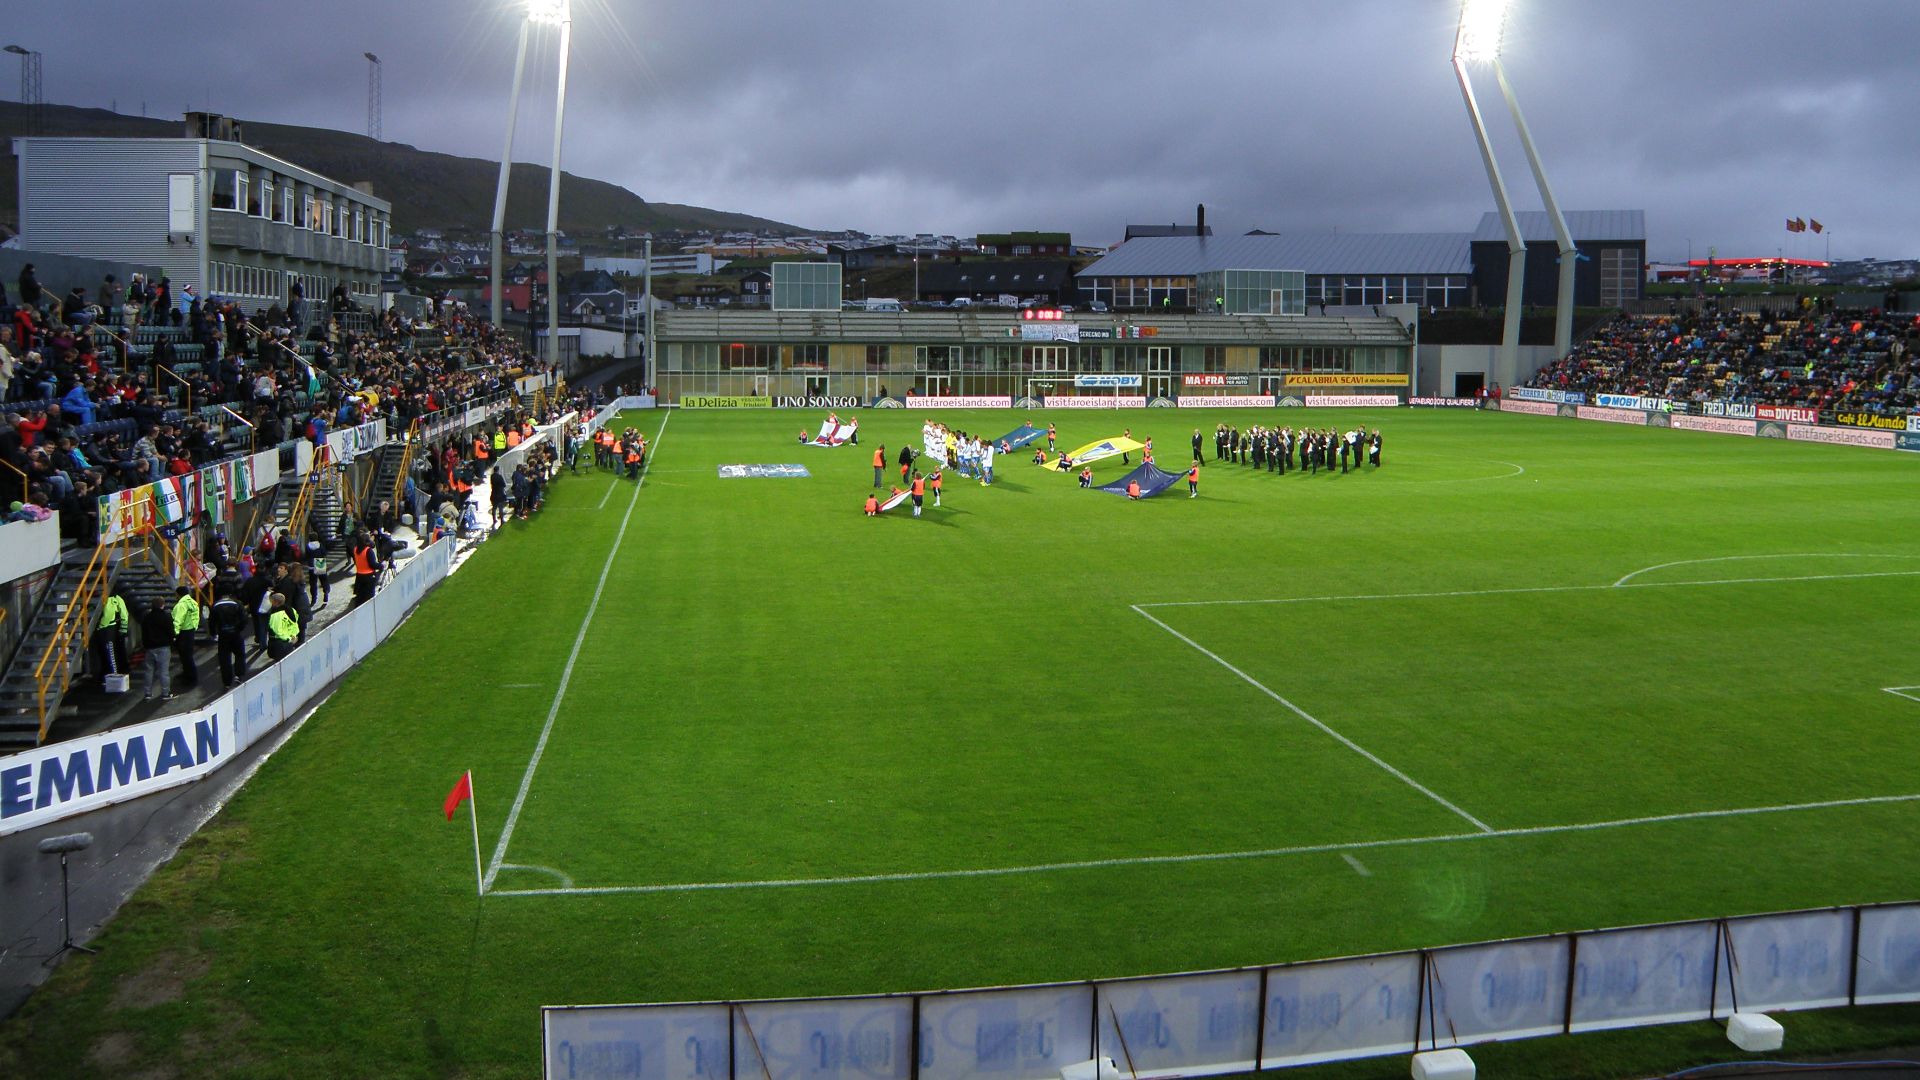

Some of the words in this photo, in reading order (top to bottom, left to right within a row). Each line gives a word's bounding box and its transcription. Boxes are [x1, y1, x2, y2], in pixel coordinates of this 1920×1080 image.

[1099, 376, 1139, 385] MOBY
[1296, 376, 1338, 384] CALABRIA
[1340, 376, 1364, 384] SCAVI
[685, 397, 695, 407] la
[698, 397, 738, 407] Delizia
[777, 396, 806, 407] LINO
[808, 396, 857, 407] SONEGO
[908, 398, 1010, 407] visitfaroeislands.com
[1046, 398, 1144, 407] visitfaroeislands.com
[1179, 398, 1273, 406] visitfaroeislands.com
[1307, 397, 1397, 405] visitfaroeislands.com
[1610, 396, 1639, 407] MOBY
[1702, 402, 1724, 416] FRED
[1725, 403, 1756, 418] MELLO
[1758, 408, 1775, 418] PASTA
[1775, 408, 1814, 422] DIVELLA
[1838, 413, 1855, 425] Café
[1856, 413, 1868, 426] El
[1868, 414, 1906, 429] Mundo
[1788, 427, 1893, 447] visitfaroeislands.com
[167, 529, 176, 537] 15
